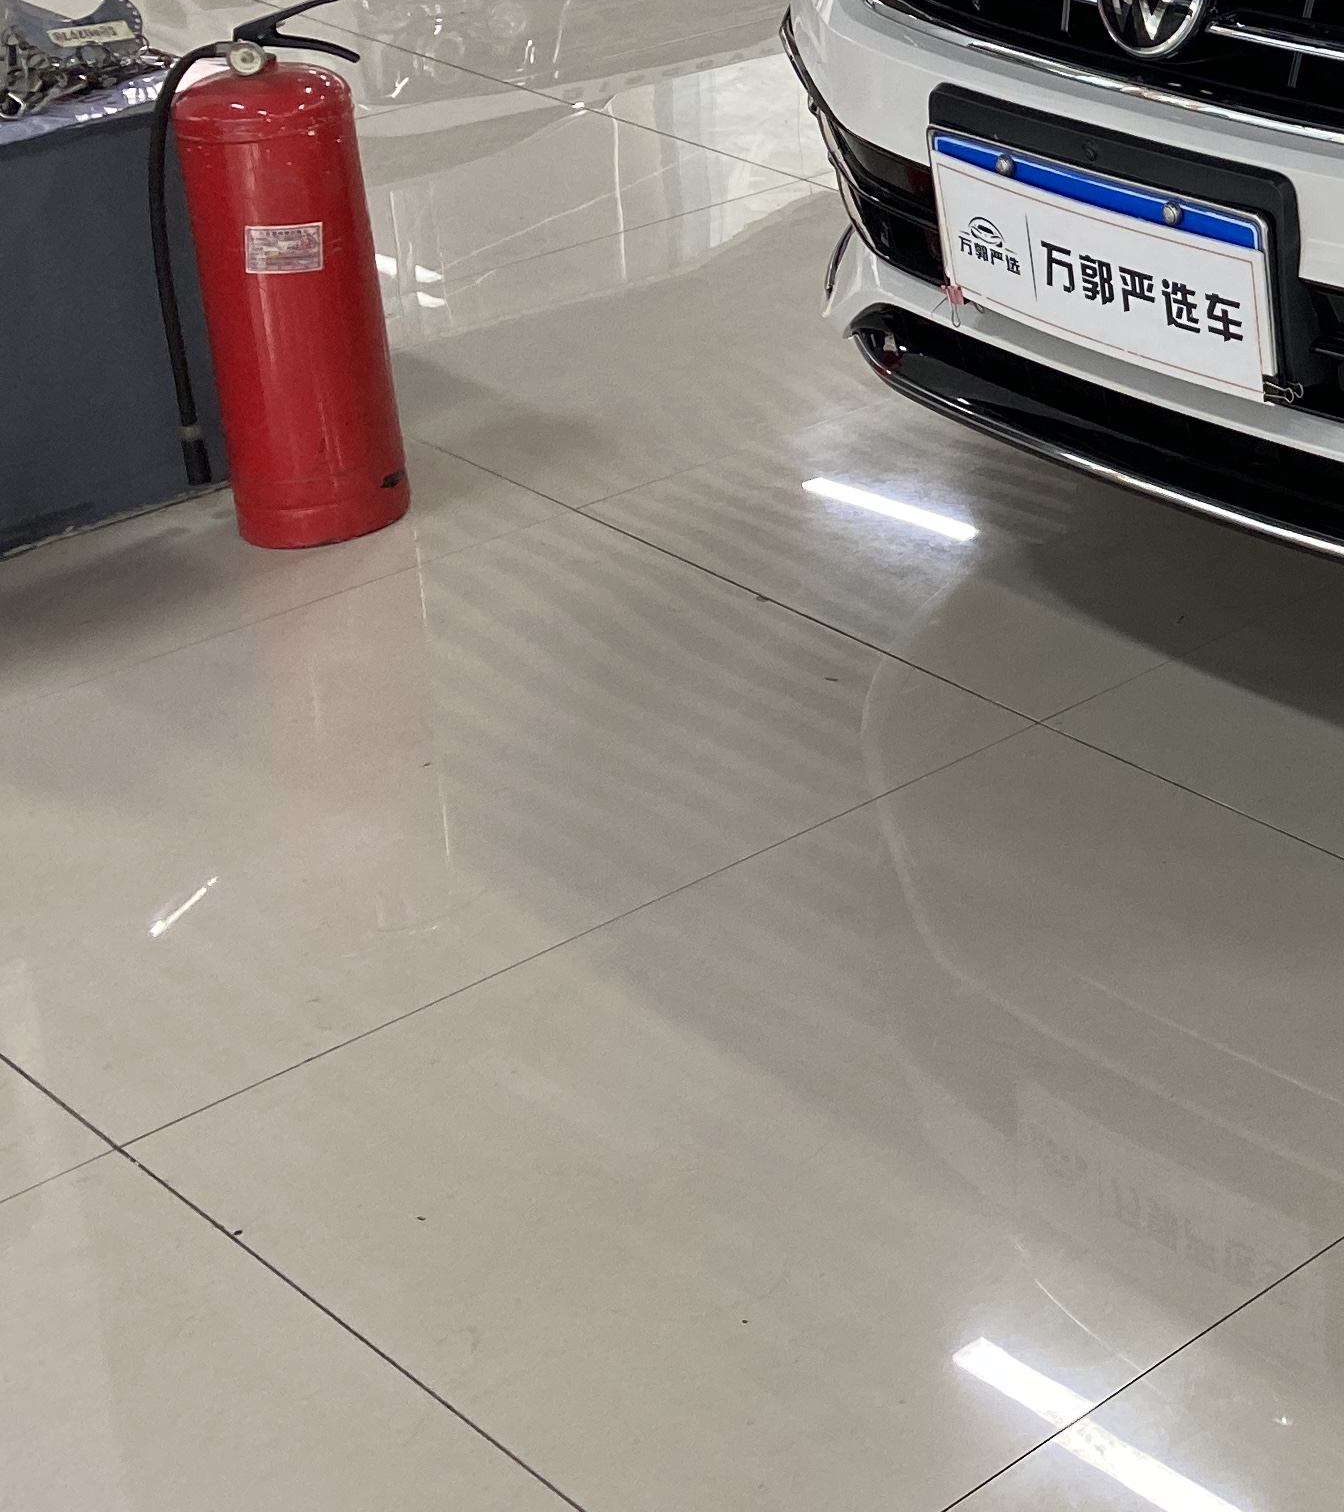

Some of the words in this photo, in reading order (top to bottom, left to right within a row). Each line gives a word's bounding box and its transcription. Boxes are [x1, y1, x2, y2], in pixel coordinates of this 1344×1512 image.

[958, 235, 1021, 276] 万郭严选
[1040, 240, 1244, 342] 万郭严选车
